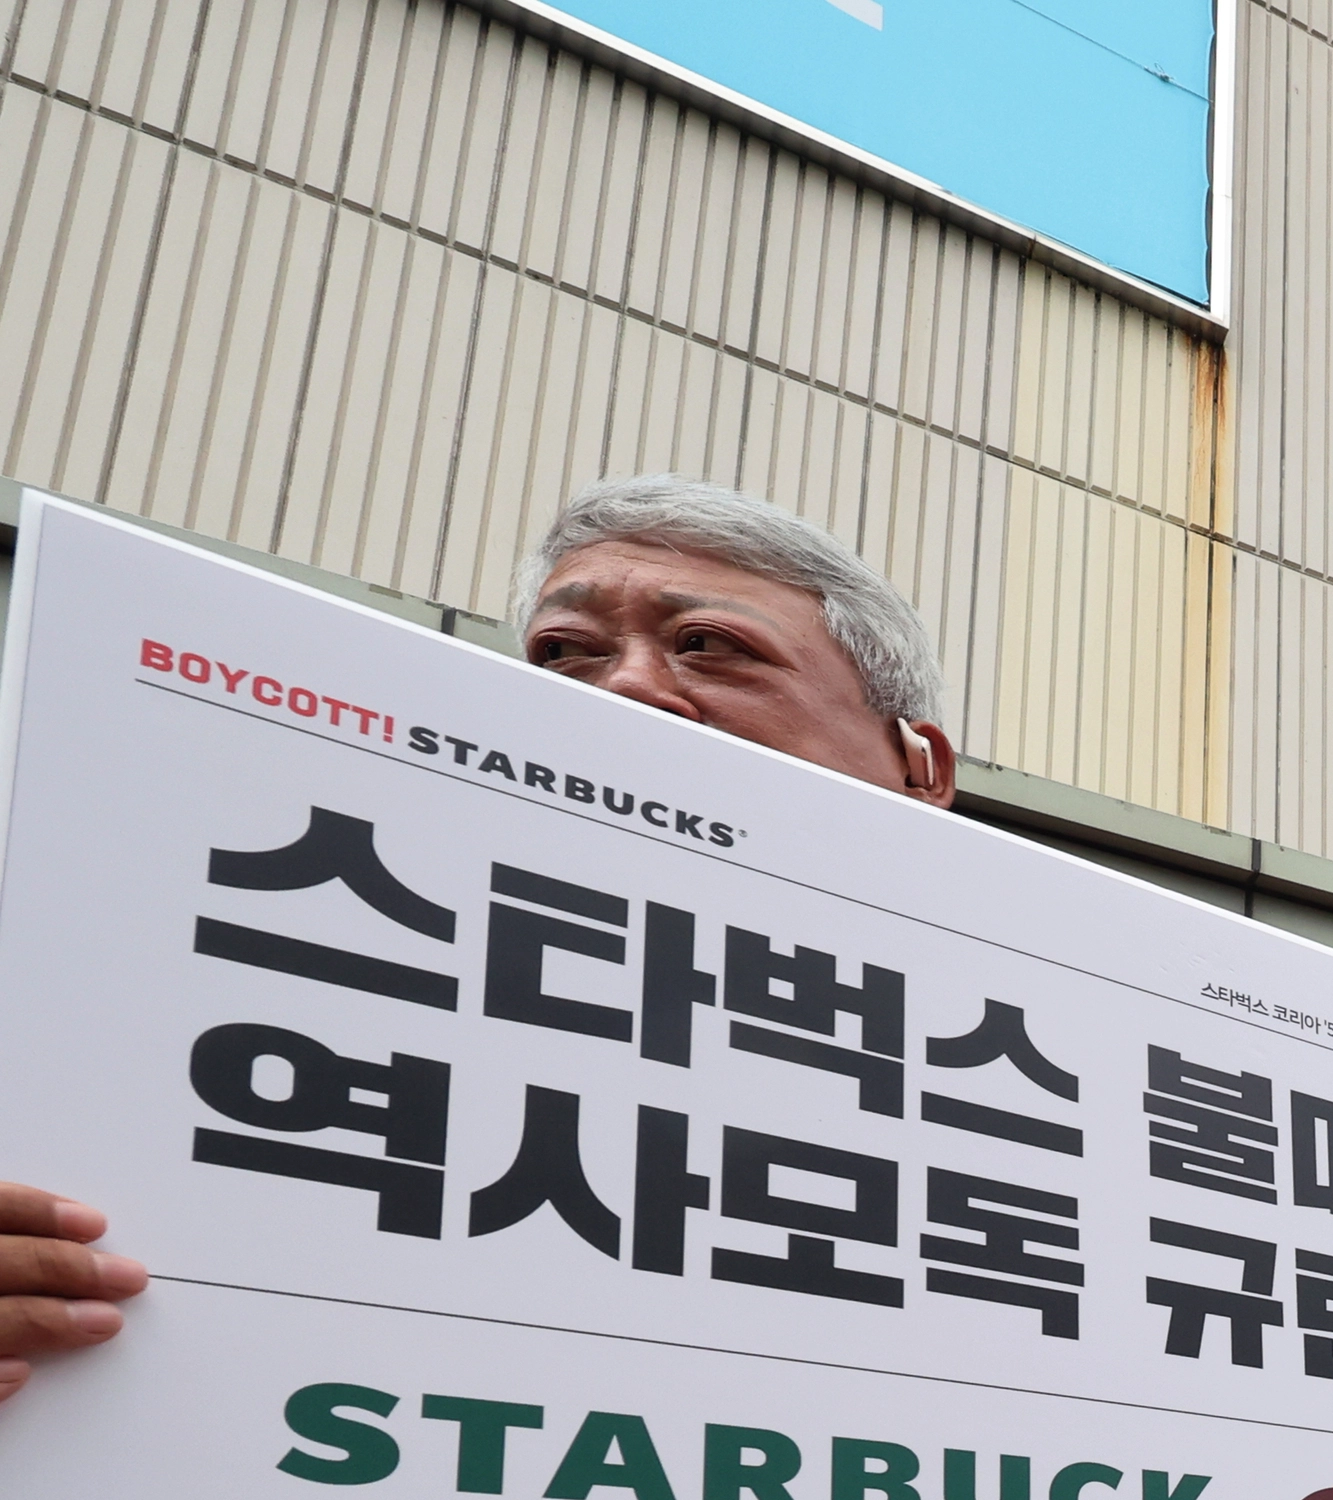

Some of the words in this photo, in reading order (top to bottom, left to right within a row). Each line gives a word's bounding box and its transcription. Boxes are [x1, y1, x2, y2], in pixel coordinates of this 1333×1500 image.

[138, 637, 395, 743] BOYCOTT!
[407, 725, 737, 848] STARBUCKS
[193, 804, 1083, 1159] 스타벅스
[1200, 982, 1270, 1017] 스타벅스
[1272, 1004, 1321, 1035] 코리아
[187, 1020, 1086, 1341] 역사모독
